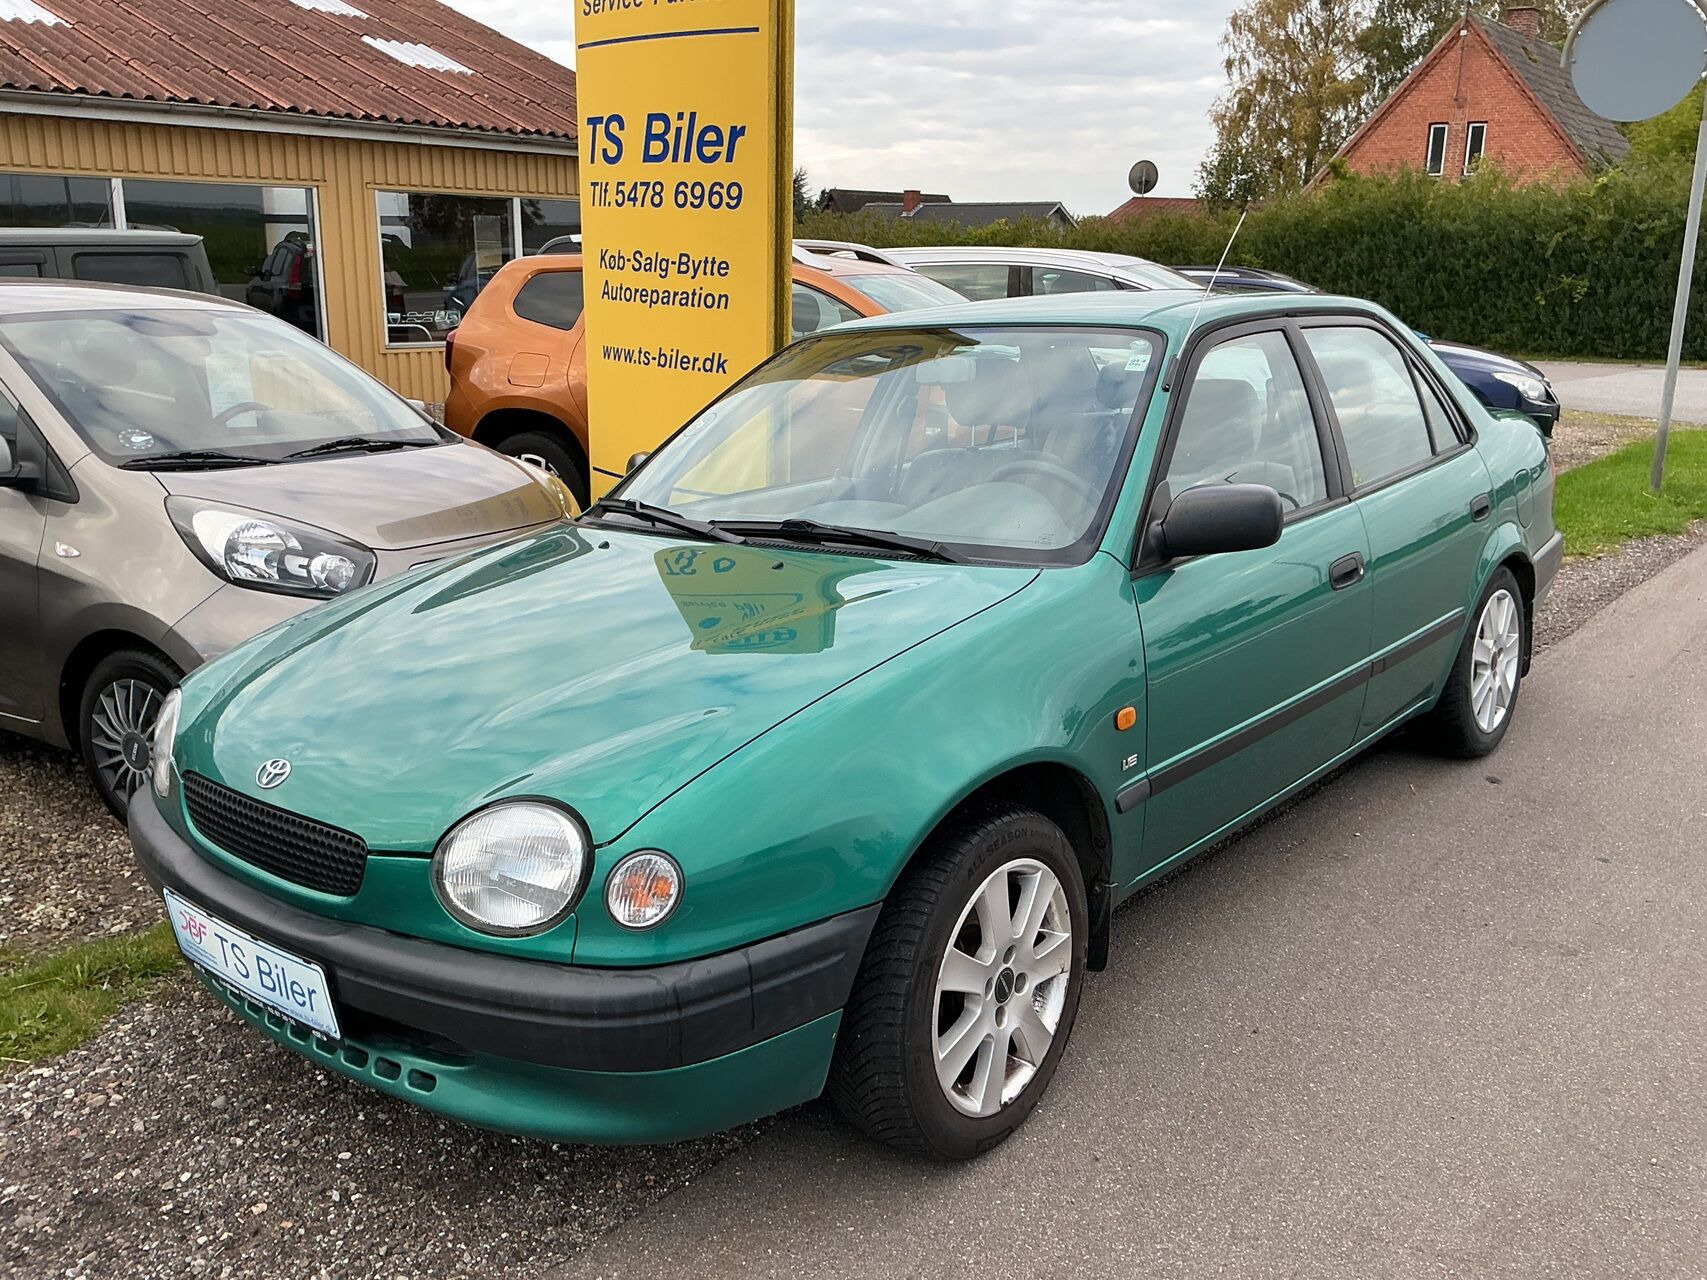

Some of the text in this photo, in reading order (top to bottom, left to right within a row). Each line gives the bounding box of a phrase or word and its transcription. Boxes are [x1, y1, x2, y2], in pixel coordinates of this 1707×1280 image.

[586, 111, 747, 165] TS Biler
[674, 181, 744, 210] 6969
[599, 249, 730, 281] Køb-Salg-Bytte
[601, 280, 730, 310] Autoreparation
[602, 344, 729, 375] www.ts-biler.dk
[967, 827, 1029, 880] ALL SEASON
[213, 932, 250, 980] TS
[255, 954, 317, 1012] Biler
